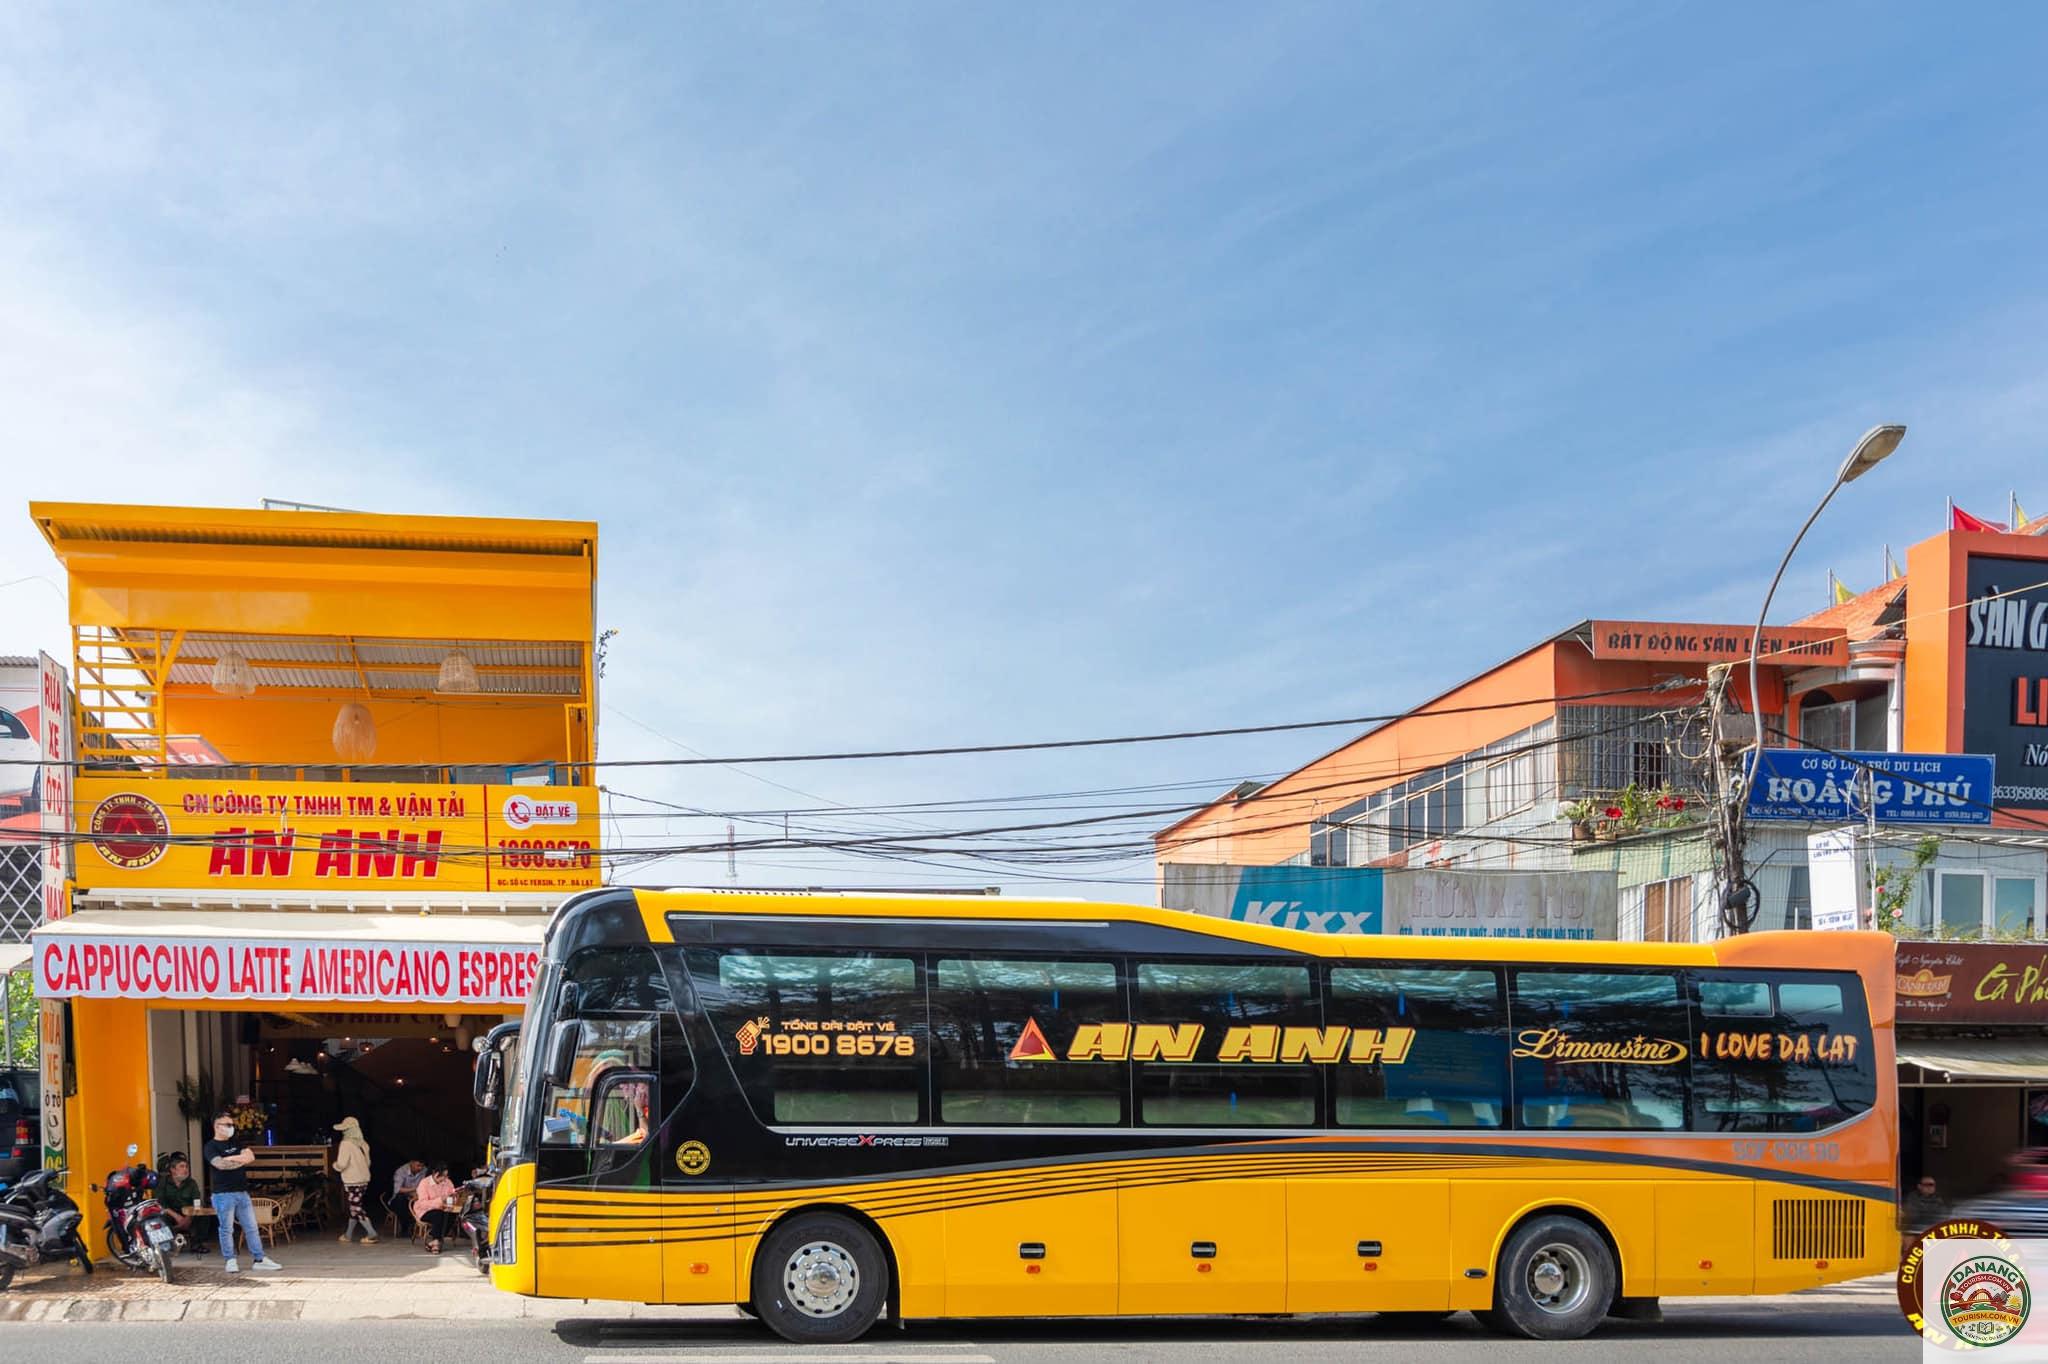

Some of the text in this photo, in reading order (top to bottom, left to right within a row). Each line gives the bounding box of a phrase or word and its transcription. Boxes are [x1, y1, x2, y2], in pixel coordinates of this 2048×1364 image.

[1968, 585, 2027, 649] SÀN
[1648, 631, 1698, 655] ĐỘNG
[1743, 636, 1783, 655] LÊN
[1788, 639, 1834, 656] MINH
[48, 719, 60, 761] XE
[1802, 757, 1820, 770] CƠ
[1840, 758, 1866, 772] LƯ
[1894, 760, 1911, 772] DU
[1913, 761, 1941, 774] LỊCH
[183, 790, 465, 822] CN CÔNG TY TNHH TM & VẬN TẢI
[1902, 776, 1972, 806] PHÚ
[208, 827, 443, 879] AN ANH
[1244, 900, 1374, 934] Kixx
[43, 942, 539, 998] CAPPUCCINO LATTE AMERICANO ESPRES
[781, 1019, 818, 1031] TỔNG
[761, 1033, 915, 1057] 1900 8678
[1066, 1022, 1416, 1064] AN ANH
[1511, 1028, 1687, 1064] Limousine
[1701, 1031, 1858, 1063] I LOVE DA LAT
